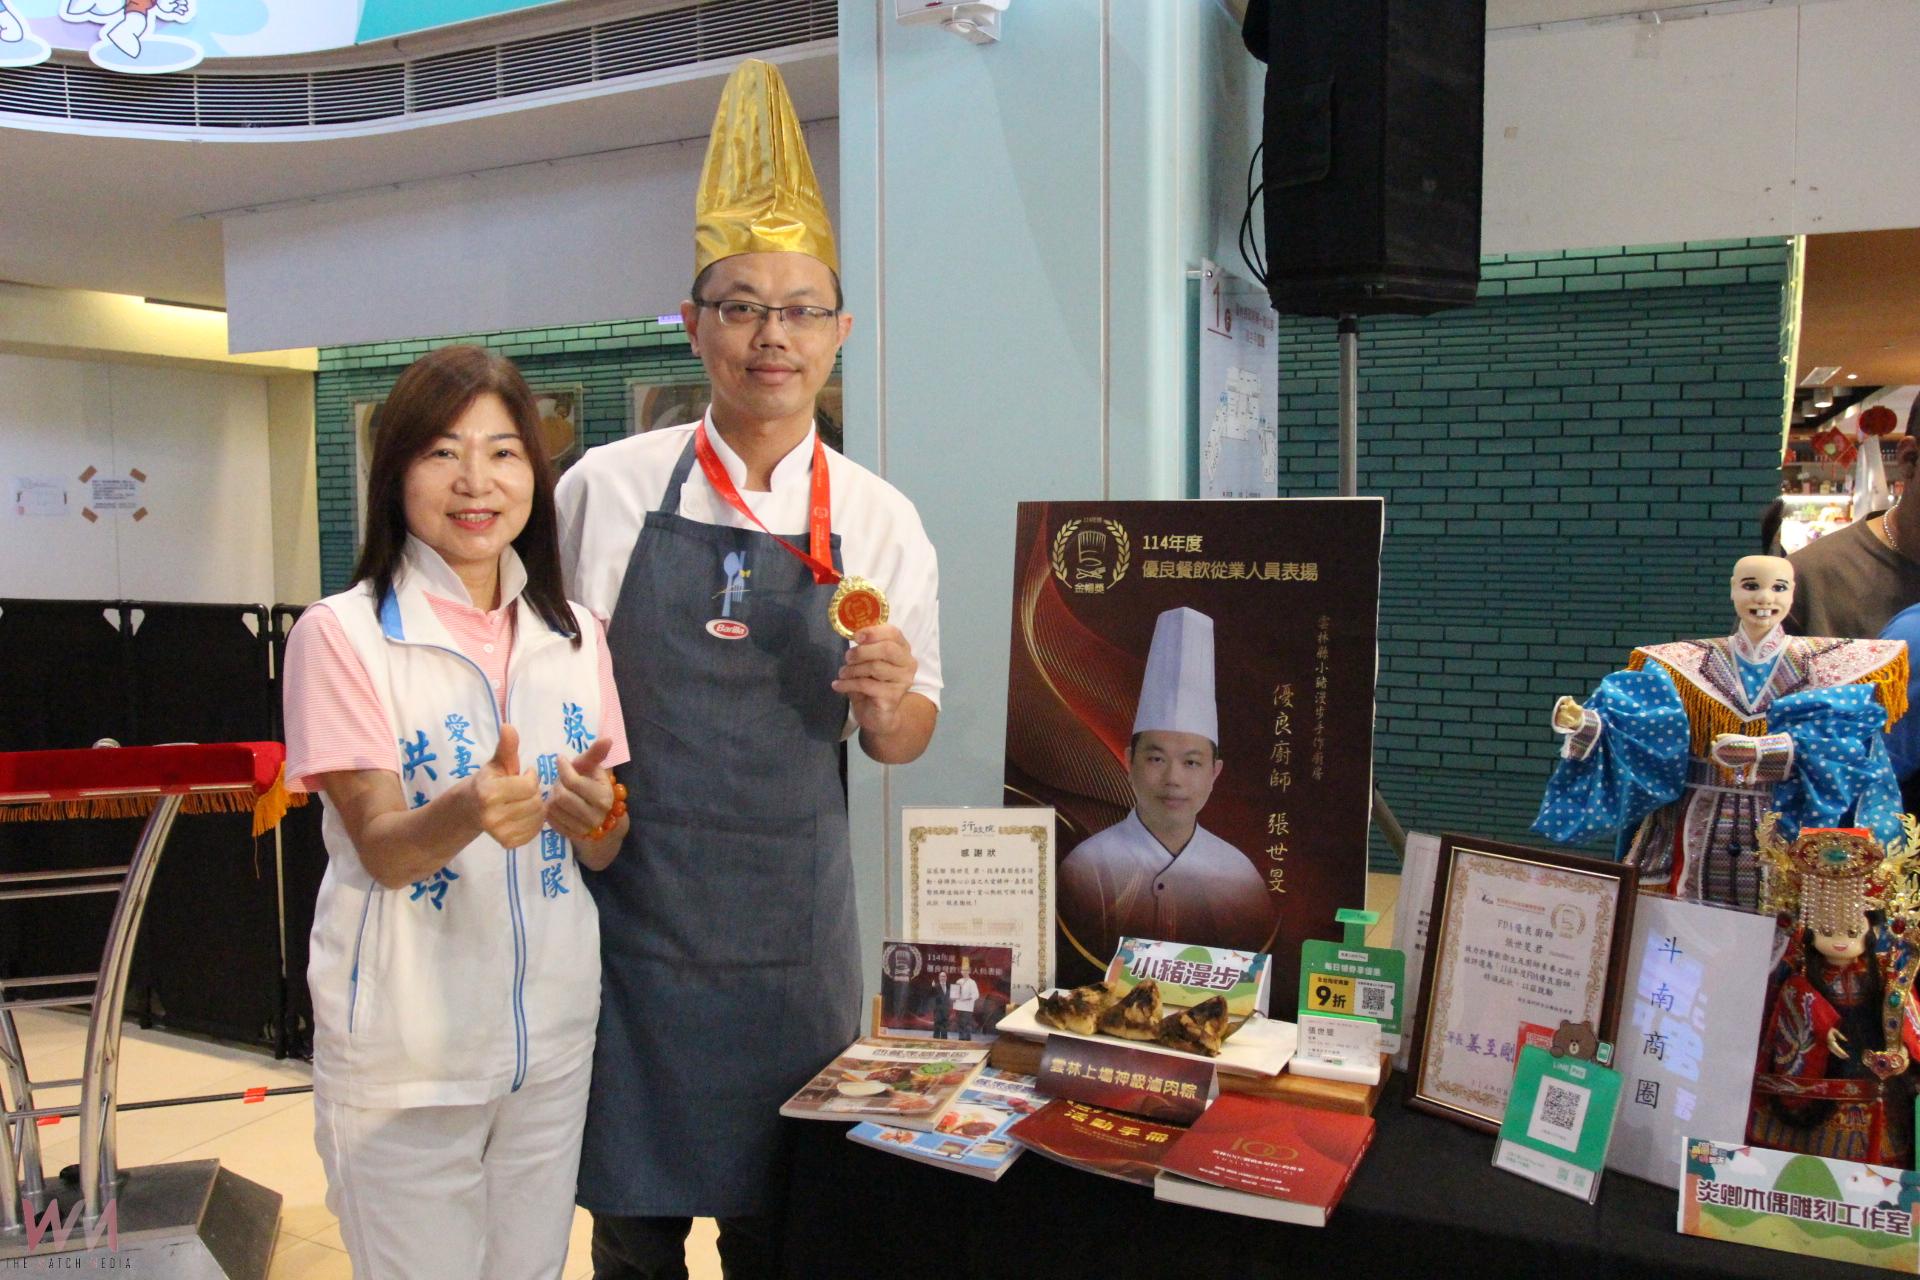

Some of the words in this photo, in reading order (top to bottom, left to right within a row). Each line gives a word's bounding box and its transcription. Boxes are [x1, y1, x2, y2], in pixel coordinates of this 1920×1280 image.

[1142, 534, 1203, 553] 114年度
[1142, 561, 1319, 582] 優良餐飲從業人員表揚
[715, 623, 745, 636] Barilla
[444, 712, 481, 779] 愛妻
[1268, 682, 1295, 793] 優良廚師
[537, 752, 570, 899] 服團隊
[1130, 955, 1242, 992] 小豬漫步
[1635, 936, 1683, 1110] 斗南商圈
[1063, 1109, 1170, 1143] 活動手冊
